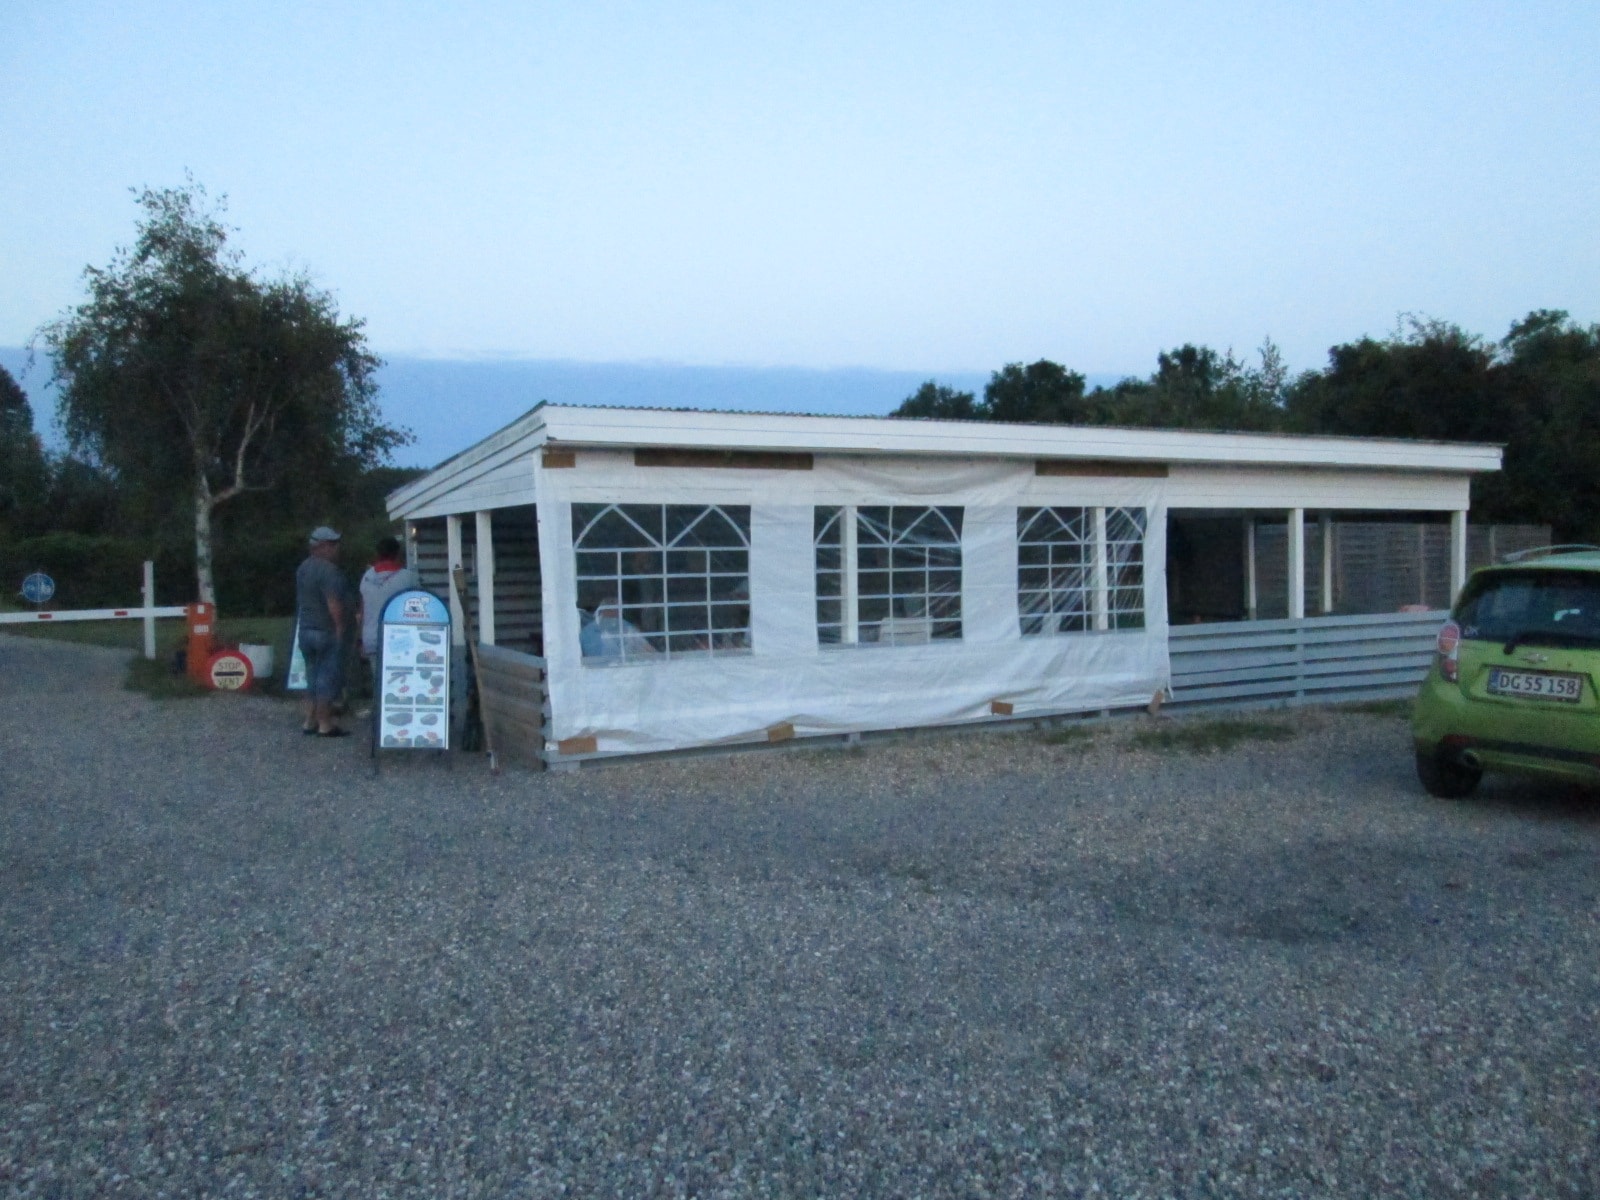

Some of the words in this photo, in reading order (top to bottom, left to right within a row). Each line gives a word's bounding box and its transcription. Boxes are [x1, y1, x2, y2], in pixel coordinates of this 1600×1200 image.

[218, 662, 241, 670] STOP
[218, 677, 240, 686] VENT
[1500, 674, 1520, 690] DG
[1524, 676, 1542, 691] 55
[1548, 679, 1576, 695] 158
